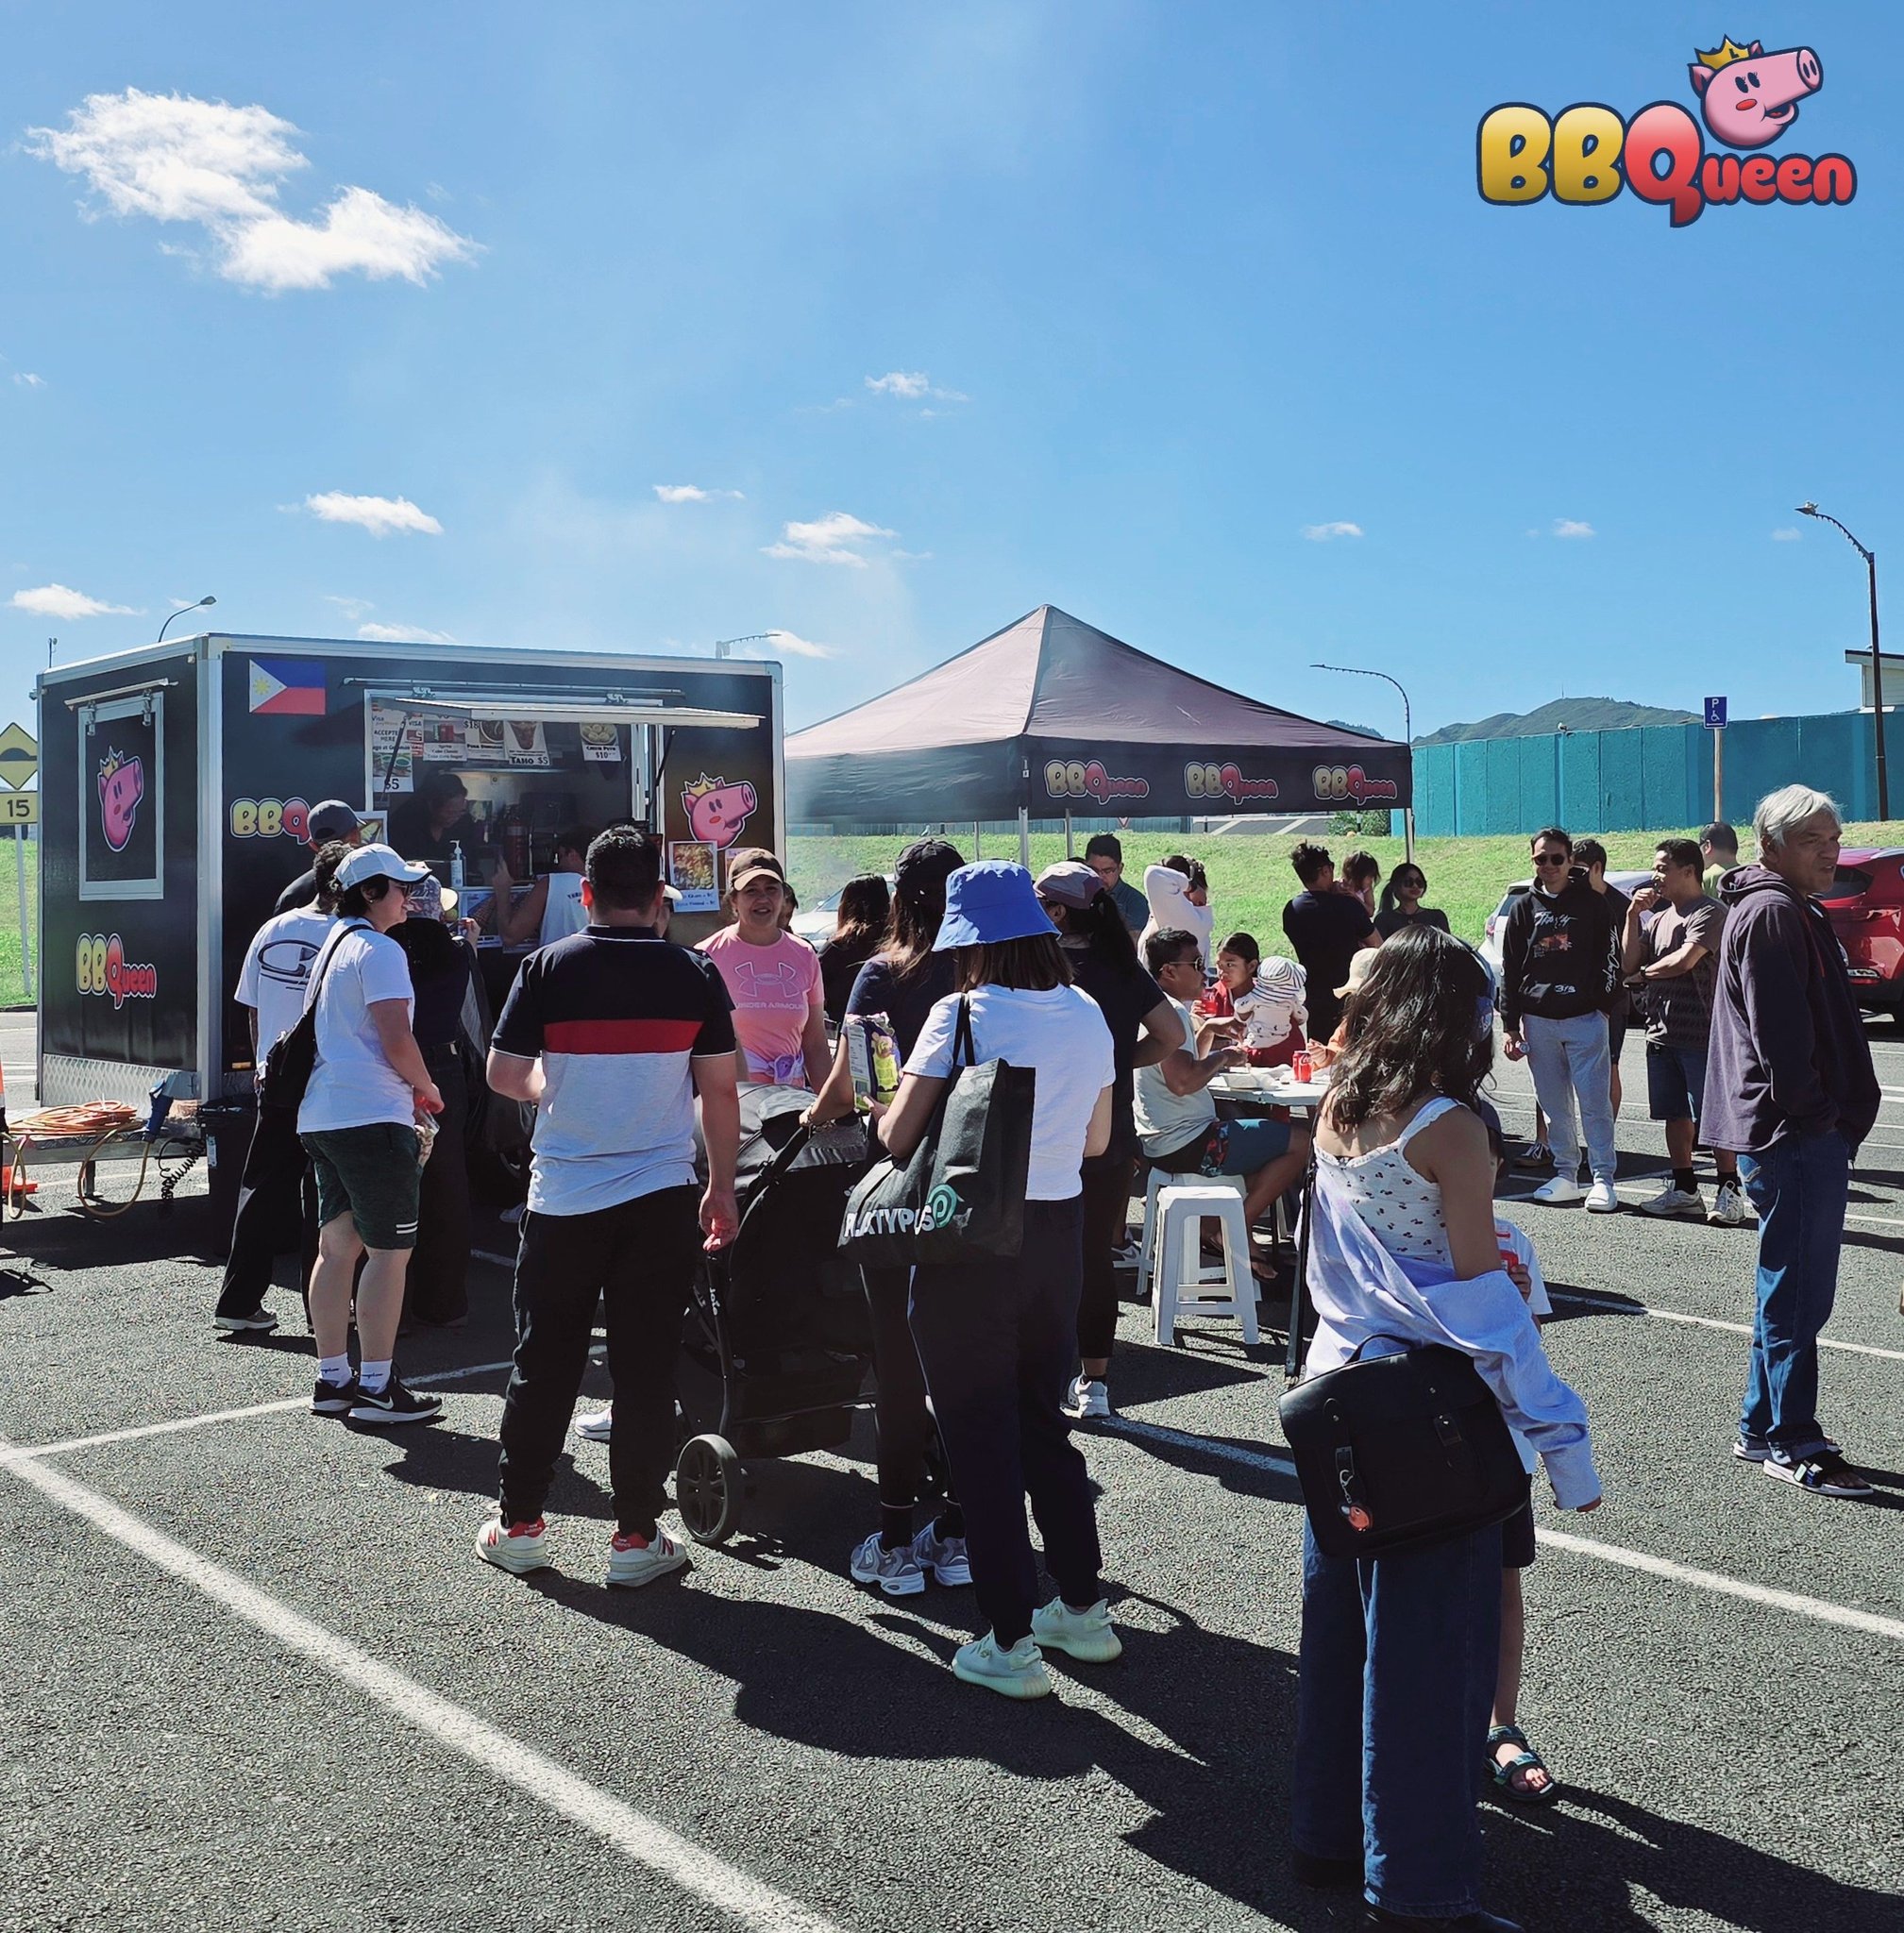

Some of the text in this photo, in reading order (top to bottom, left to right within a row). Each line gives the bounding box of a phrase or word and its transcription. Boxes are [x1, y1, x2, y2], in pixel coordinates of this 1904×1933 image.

[1711, 698, 1720, 709] P
[1044, 760, 1149, 805] BBQueen
[1185, 762, 1278, 805] BBQueen
[1312, 764, 1397, 805] BBQueen
[7, 798, 30, 818] 15
[76, 933, 157, 1010] BBQueen
